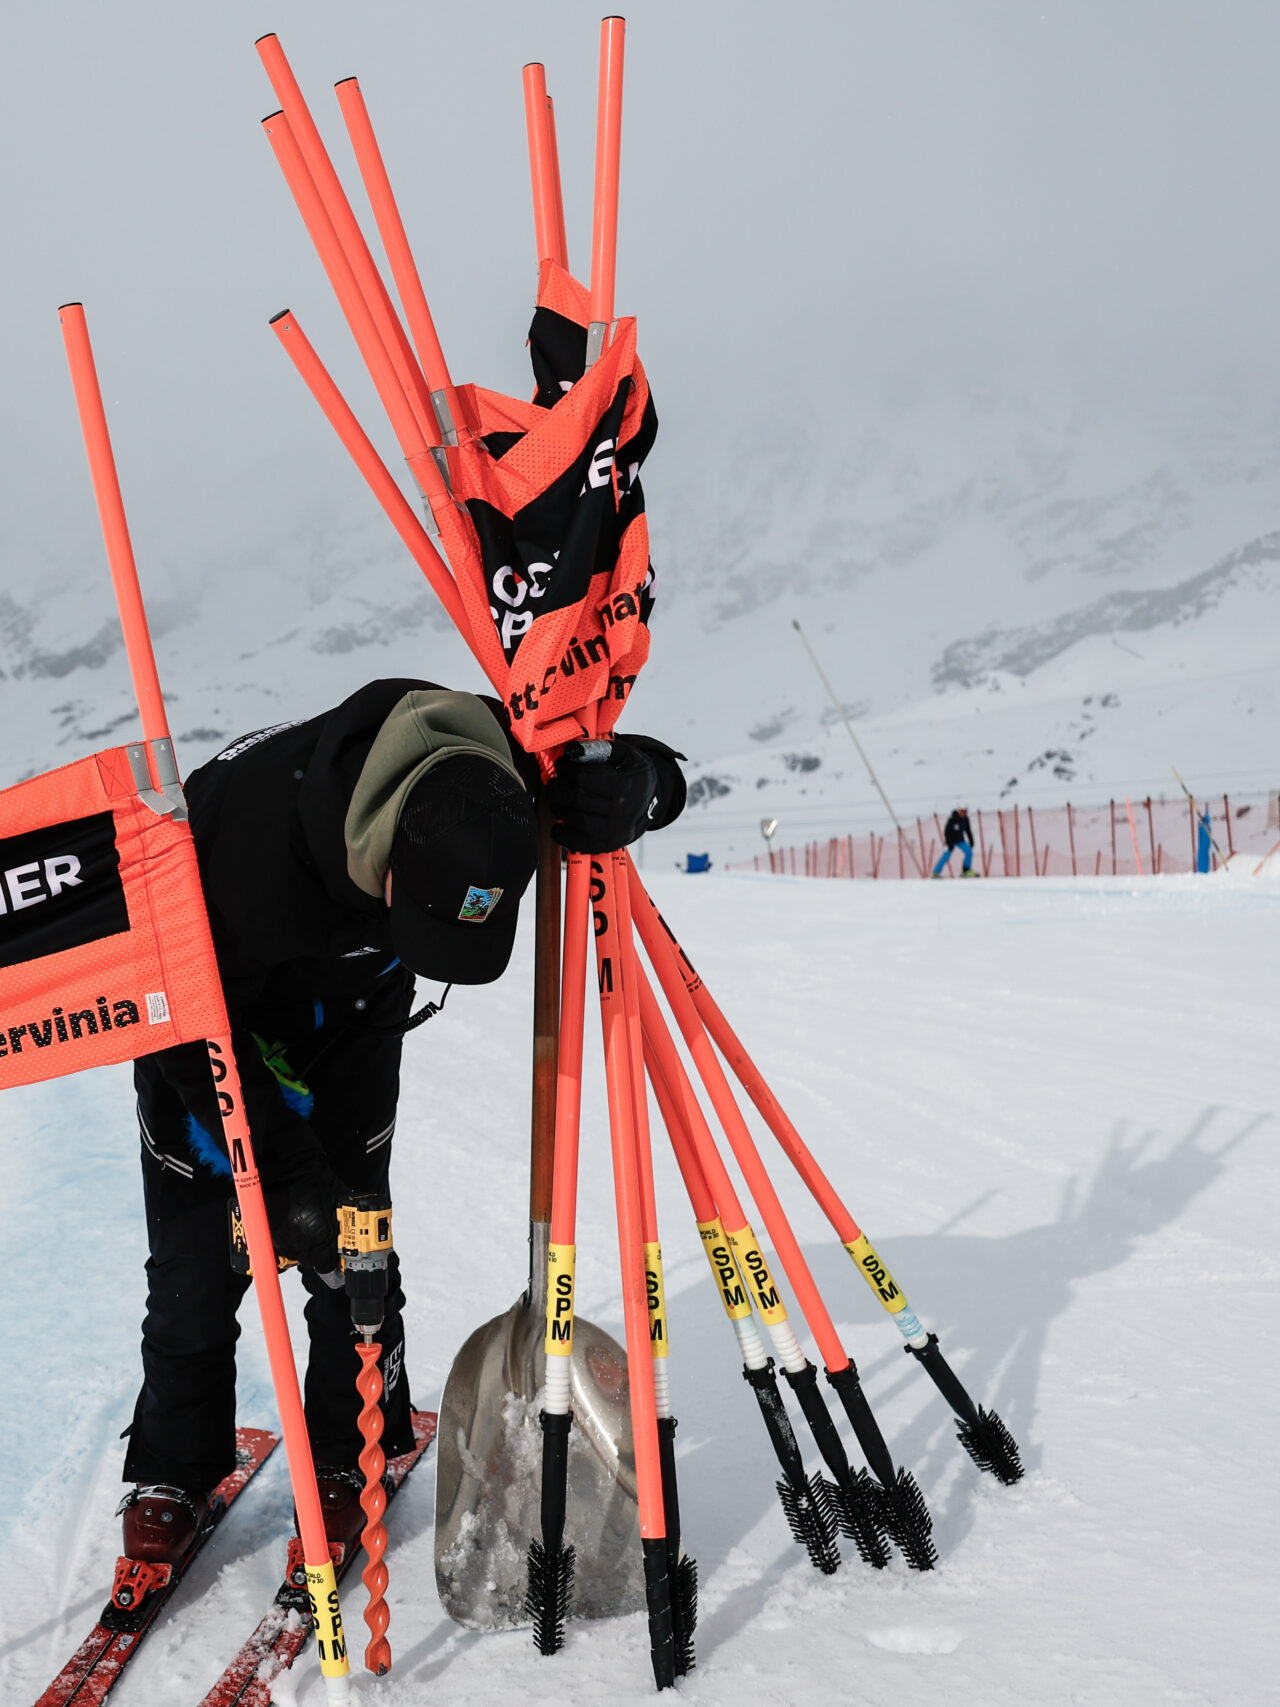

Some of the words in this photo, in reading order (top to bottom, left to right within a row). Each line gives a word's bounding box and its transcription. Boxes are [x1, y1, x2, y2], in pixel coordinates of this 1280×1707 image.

[712, 1247, 745, 1307] SPM
[745, 1250, 780, 1310] SPM
[862, 1255, 899, 1302] SPM
[551, 1274, 572, 1341] SPM
